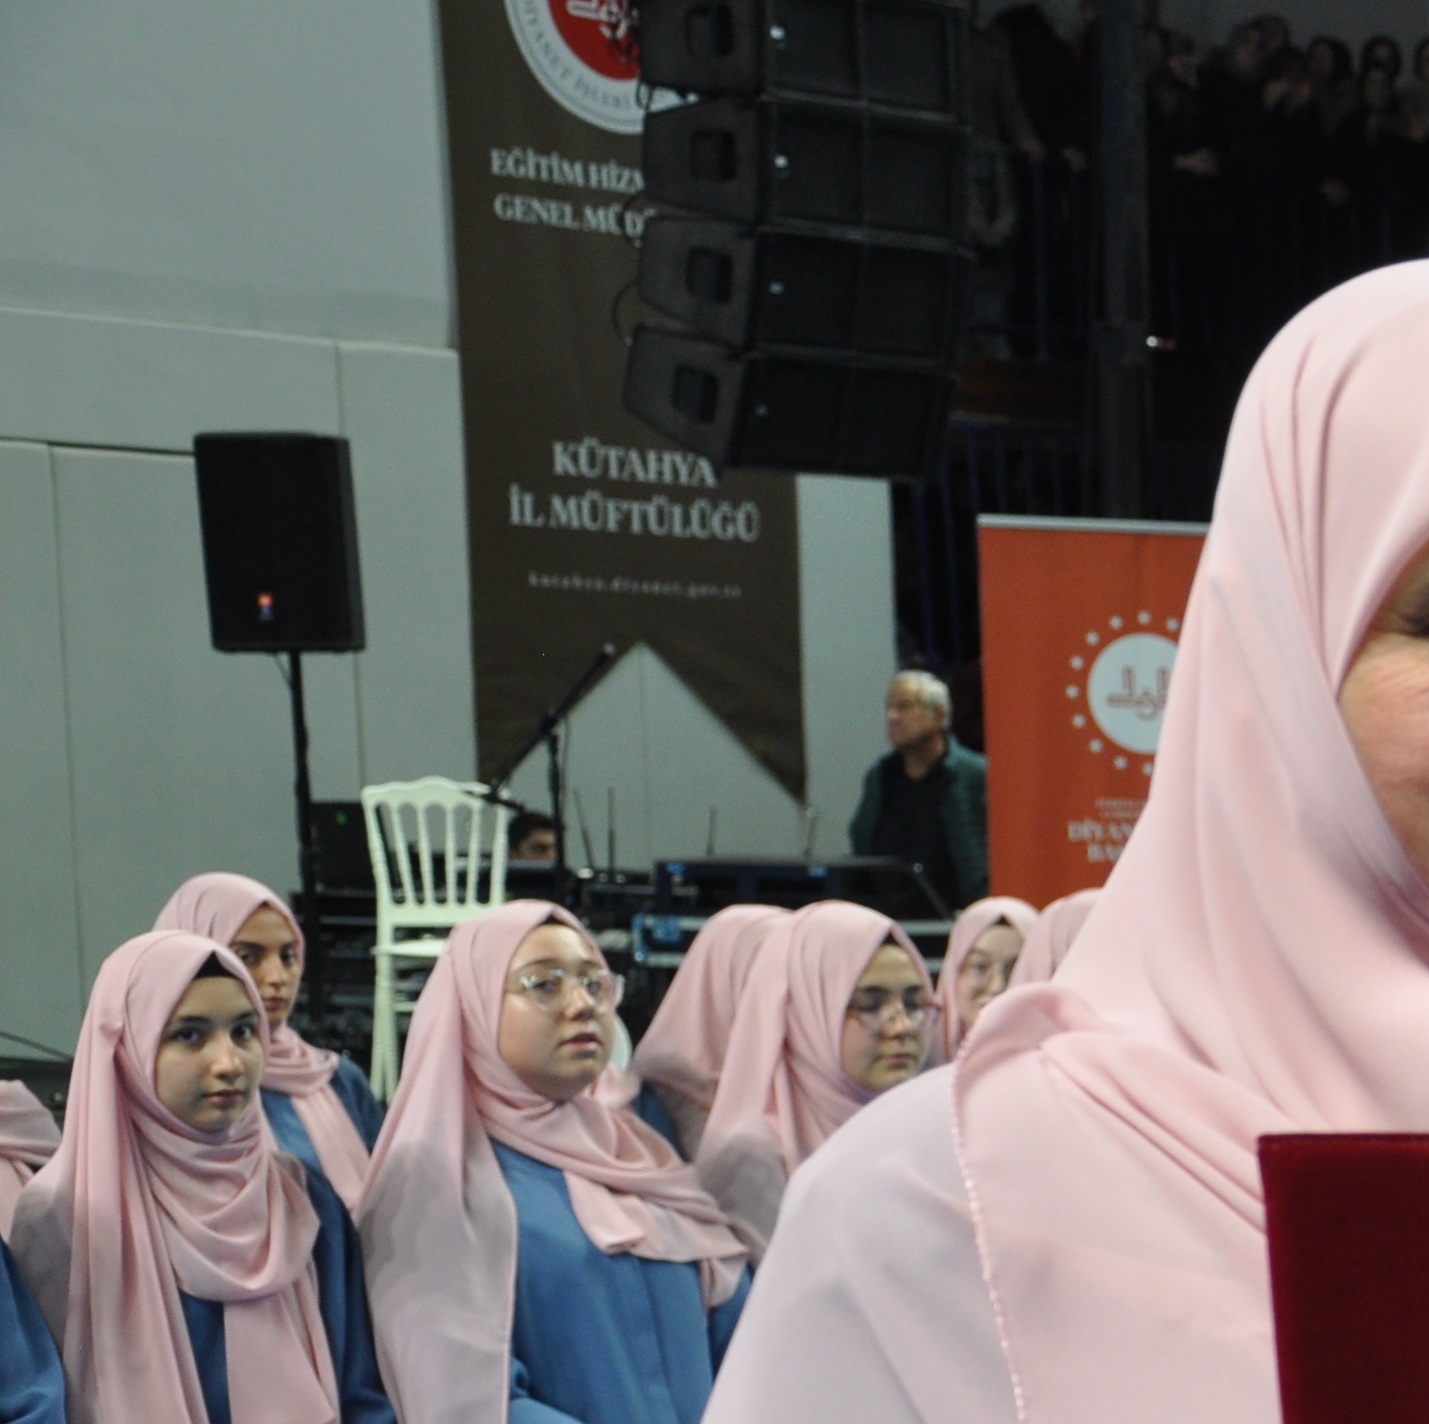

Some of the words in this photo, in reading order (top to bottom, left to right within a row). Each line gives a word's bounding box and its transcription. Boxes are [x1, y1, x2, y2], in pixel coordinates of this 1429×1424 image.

[494, 194, 580, 229] GENEL
[554, 435, 718, 489] KÜTAHYA
[509, 482, 547, 528] İL
[549, 489, 761, 543] MÜFTÜLÜĞÜ
